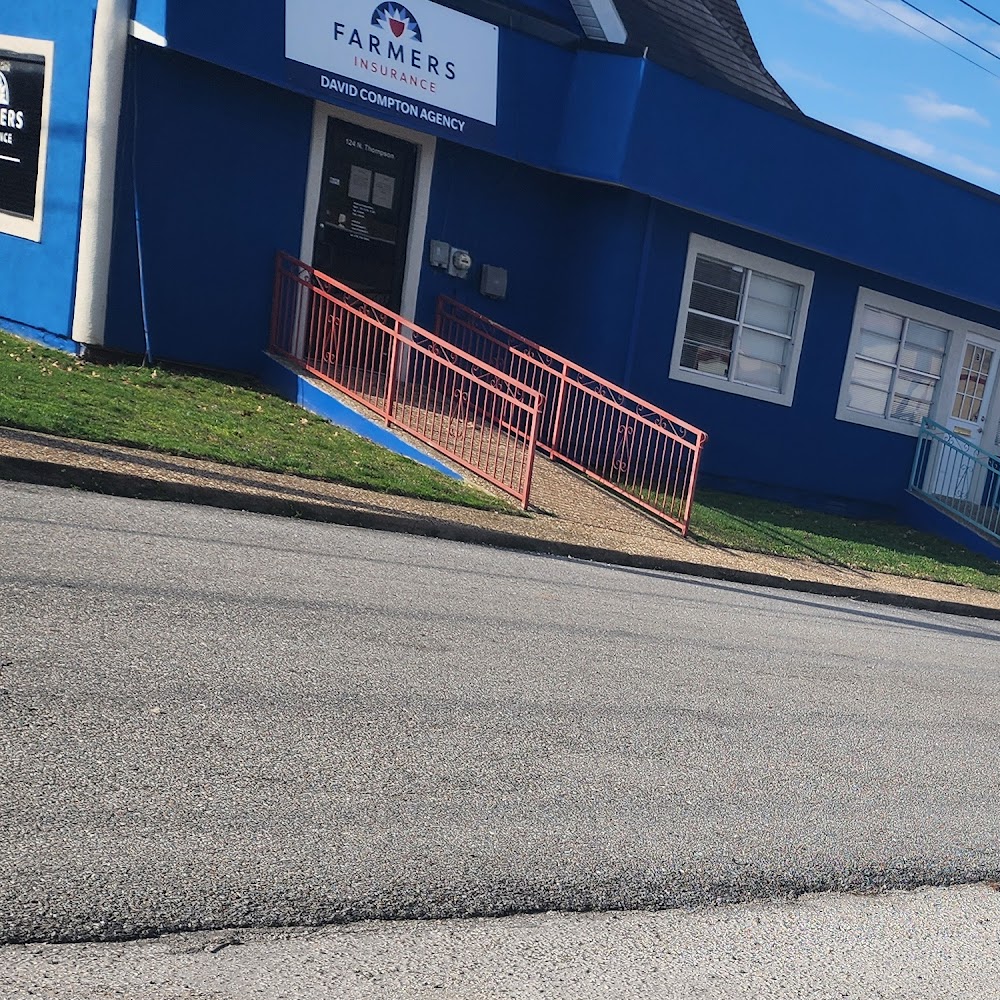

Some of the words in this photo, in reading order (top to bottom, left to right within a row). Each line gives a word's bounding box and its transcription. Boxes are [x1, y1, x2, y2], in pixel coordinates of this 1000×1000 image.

[333, 21, 456, 80] FARMERS
[354, 56, 436, 93] INSURANCE
[320, 75, 357, 98] DAVID
[359, 88, 418, 118] COMPTON
[419, 108, 465, 133] AGENCY
[365, 143, 395, 159] Thompson
